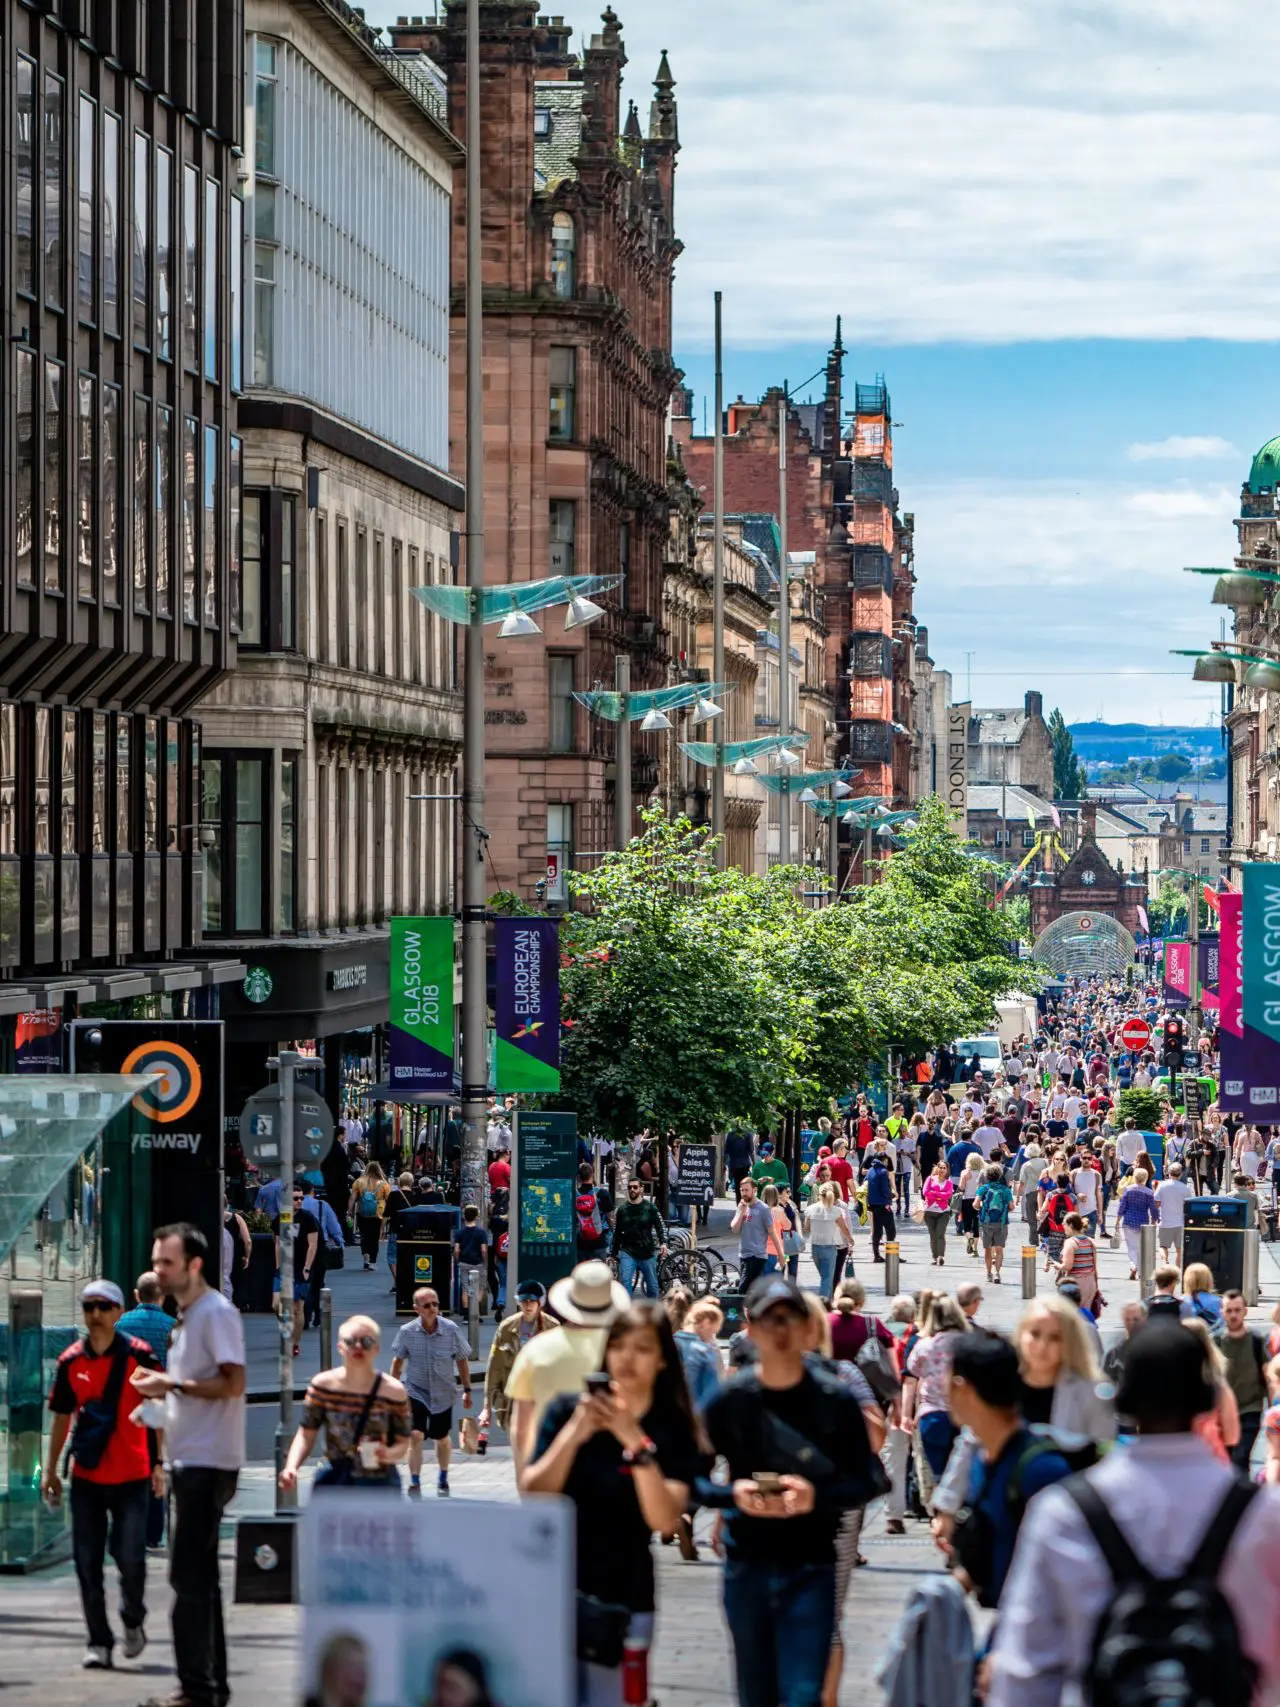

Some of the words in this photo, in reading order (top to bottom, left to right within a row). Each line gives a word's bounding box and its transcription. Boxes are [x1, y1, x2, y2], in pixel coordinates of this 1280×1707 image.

[949, 715, 965, 737] ST
[404, 930, 422, 1026] GLASGOW
[515, 930, 530, 1015] EUROPEAN
[530, 930, 541, 1014] CHAMPIONSHIPS
[1171, 948, 1179, 985] GLASGOW
[423, 984, 439, 1025] 2018
[686, 1148, 708, 1157] Apple
[681, 1169, 710, 1178] Repairs
